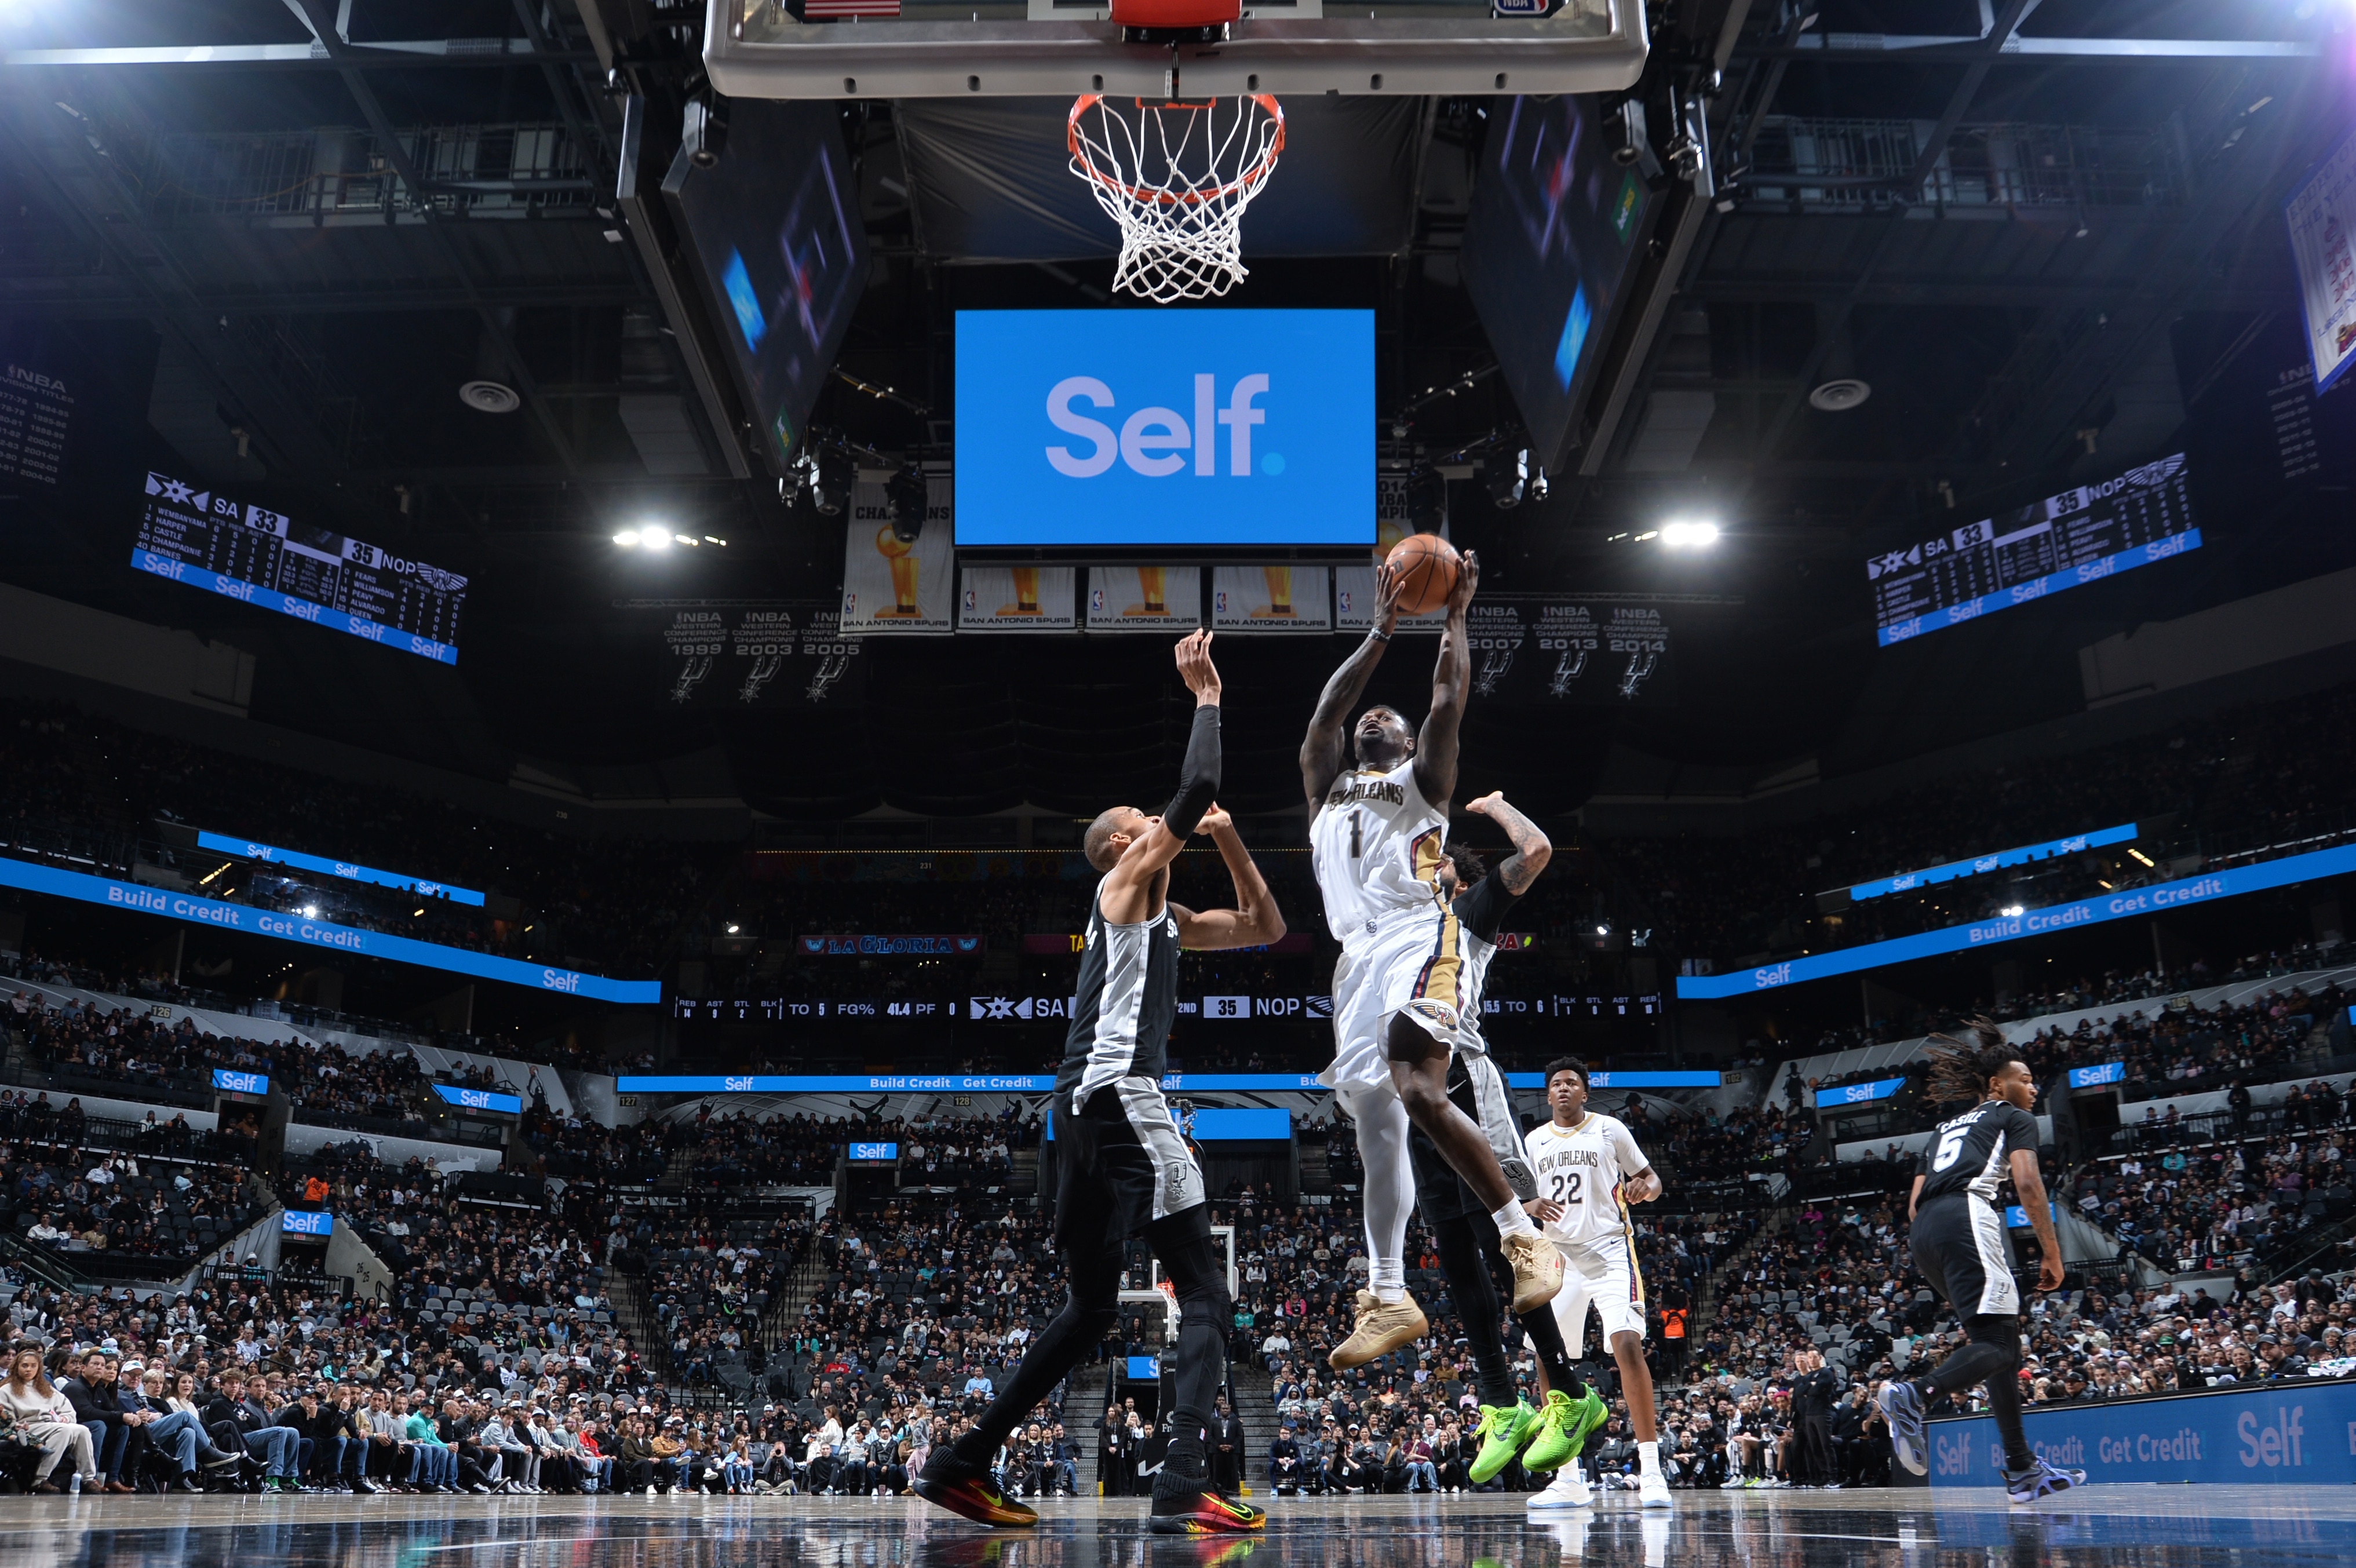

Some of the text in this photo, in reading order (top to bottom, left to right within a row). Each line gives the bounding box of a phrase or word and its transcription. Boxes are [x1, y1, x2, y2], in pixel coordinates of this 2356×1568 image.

[17, 367, 67, 393] NBA
[2088, 476, 2127, 502] NOP
[214, 497, 239, 519] SA
[2056, 491, 2079, 514] 35
[156, 516, 187, 532] HARPER
[158, 507, 207, 528] WEMBANYAMA
[254, 510, 278, 533] 33
[154, 526, 183, 541] CASTLE
[1962, 524, 1983, 546] 33
[150, 545, 181, 561] BARNES
[152, 535, 202, 557] CHAMPAGNIE
[352, 542, 374, 564] 35
[1924, 538, 1949, 557] SA
[382, 553, 417, 575] NOP
[355, 571, 377, 584] FEARS
[352, 589, 374, 601] PEAVY
[353, 580, 395, 599] WILLIAMSON
[349, 607, 372, 620] QUEEN
[350, 598, 385, 615] ALVARADO
[1479, 607, 1519, 617] NBA
[1549, 606, 1591, 617] NBA
[1621, 608, 1661, 619] NBA
[683, 612, 723, 622] NBA
[752, 612, 792, 622] NBA
[1603, 625, 1669, 633] CONFERENCE
[1606, 632, 1668, 640] CHAMPIONS
[670, 643, 722, 655] 1999
[736, 644, 793, 655] 2003
[803, 644, 860, 655] 2005
[1468, 639, 1523, 650] 2007
[1540, 639, 1599, 650] 2013
[1610, 639, 1666, 652] 2014
[1348, 809, 1363, 859] 1
[108, 885, 166, 911] Build
[258, 916, 294, 936] Get
[1970, 919, 2021, 943] Build
[2109, 894, 2147, 914] Get
[828, 935, 954, 954] LA GLORIA
[152, 1006, 171, 1018] 126
[684, 1009, 771, 1019] 14 9 2 1
[789, 1002, 955, 1016] TO 5 FG% 41.4 PF 0
[1035, 998, 1064, 1017] SA
[1178, 1003, 1197, 1013] 2ND
[1218, 1000, 1237, 1016] 35
[1256, 998, 1300, 1015] NOP
[1506, 1000, 1544, 1013] TO 6
[870, 1078, 911, 1088] Build
[963, 1078, 992, 1089] Get
[1727, 1074, 1741, 1083] 102
[621, 1097, 636, 1106] 127
[954, 1096, 971, 1106] 128
[1940, 1110, 1987, 1134] CASTLE
[1932, 1126, 1971, 1173] 5
[1537, 1150, 1598, 1178] NEW ORLEANS
[1551, 1172, 1583, 1205] 22
[2099, 1436, 2132, 1464] Get
